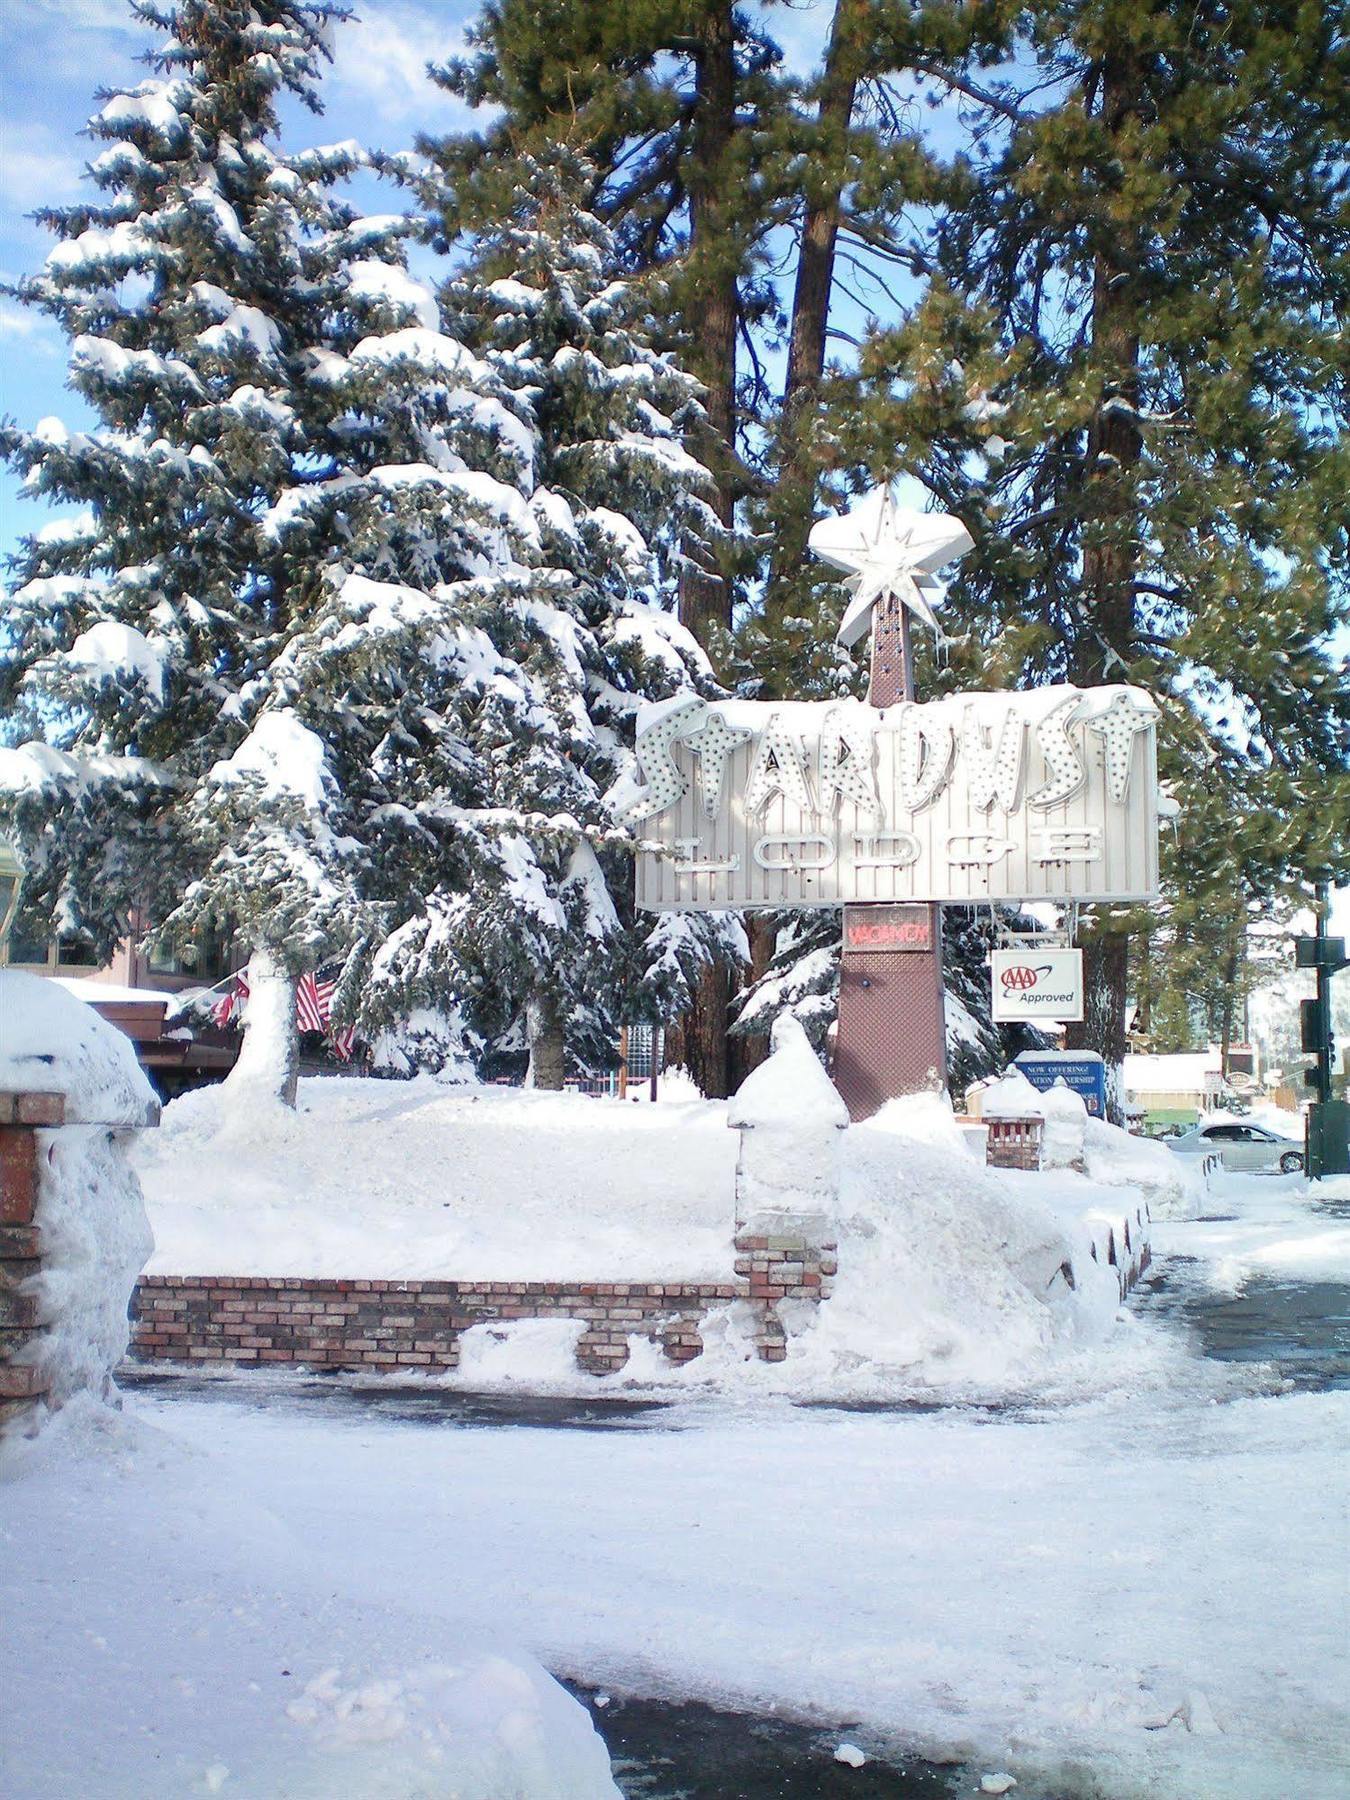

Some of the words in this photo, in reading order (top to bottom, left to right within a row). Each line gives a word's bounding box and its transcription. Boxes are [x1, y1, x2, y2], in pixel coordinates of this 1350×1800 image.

[612, 691, 1161, 826] STARDUST
[675, 826, 1103, 873] LODGE
[1004, 966, 1035, 989] AAA
[1020, 991, 1074, 1004] Approved
